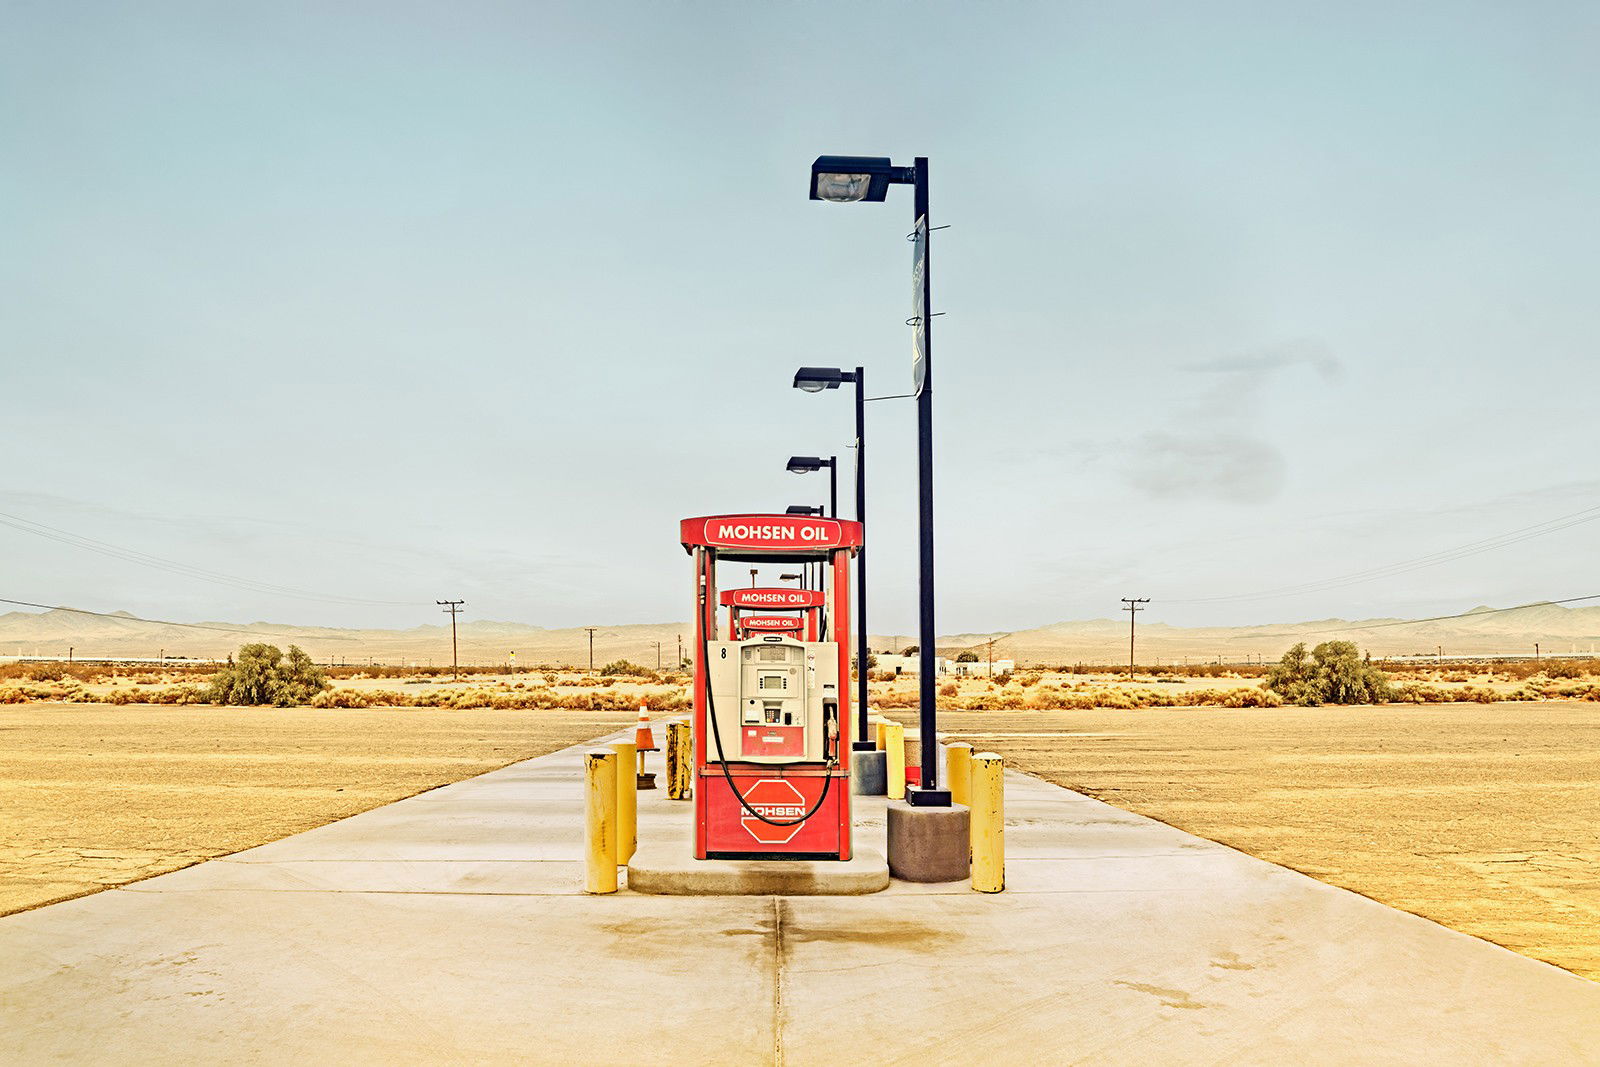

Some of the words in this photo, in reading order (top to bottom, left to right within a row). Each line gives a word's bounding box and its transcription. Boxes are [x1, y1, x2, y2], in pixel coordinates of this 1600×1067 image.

[718, 525, 794, 540] MOHSEN
[801, 526, 829, 541] OIL
[741, 593, 786, 602] MOHSEN
[788, 594, 805, 603] OIL
[781, 619, 794, 627] OIL
[721, 647, 726, 659] 8
[741, 807, 806, 816] MOHSEN
